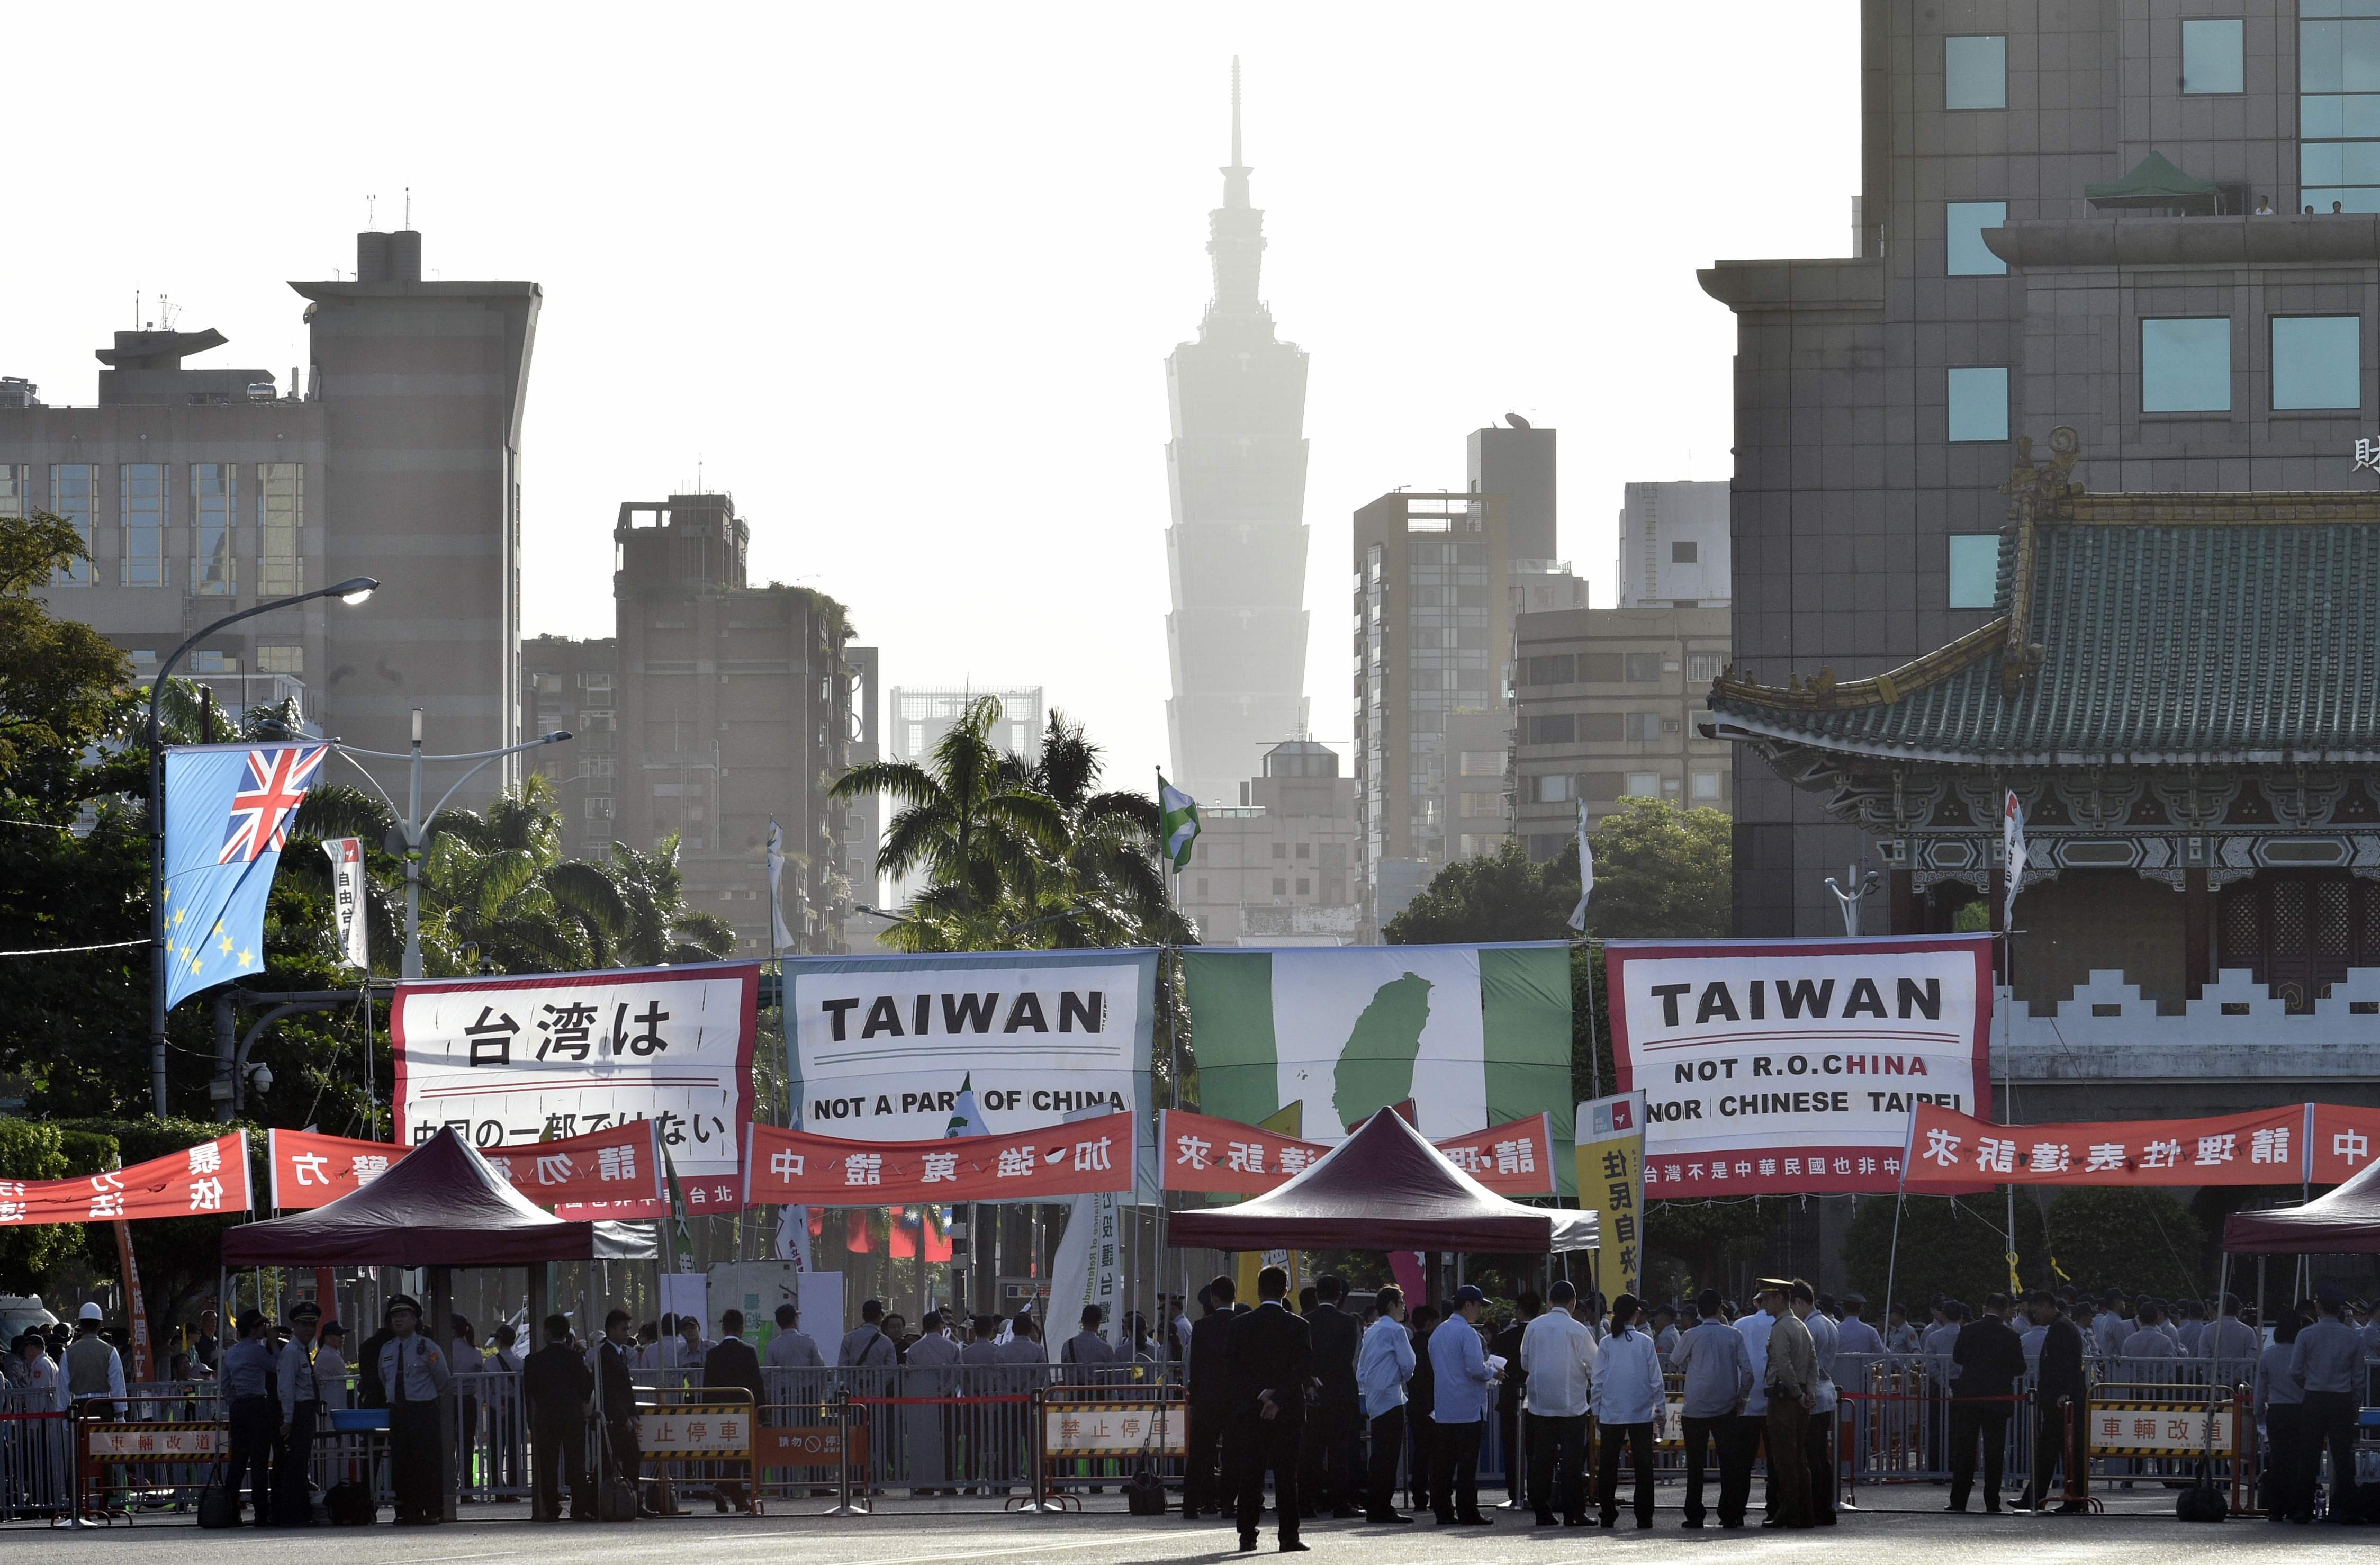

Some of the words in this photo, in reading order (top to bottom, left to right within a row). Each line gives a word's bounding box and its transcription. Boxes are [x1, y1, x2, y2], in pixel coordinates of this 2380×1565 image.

[822, 991, 1103, 1041] TAIWAN
[1651, 978, 1941, 1027] TAIWAN
[464, 1001, 669, 1067] 台湾は
[1675, 1059, 1738, 1083] NOT
[1754, 1055, 1928, 1076] R.O.CHINA
[815, 1097, 865, 1120] NOT
[874, 1095, 893, 1116] A
[902, 1091, 974, 1113] PAR
[984, 1090, 1022, 1110] OF
[1032, 1091, 1125, 1111] CHINA
[1646, 1099, 1702, 1123] NOR
[1719, 1092, 1849, 1117] CHINESE
[1644, 1157, 1900, 1184] 台灣不是中華民國也非中
[111, 1434, 210, 1451] 車輛改道
[779, 1436, 801, 1447] 請勿
[1061, 1418, 1170, 1439] 禁止停車
[2101, 1417, 2222, 1441] 車輛改道
